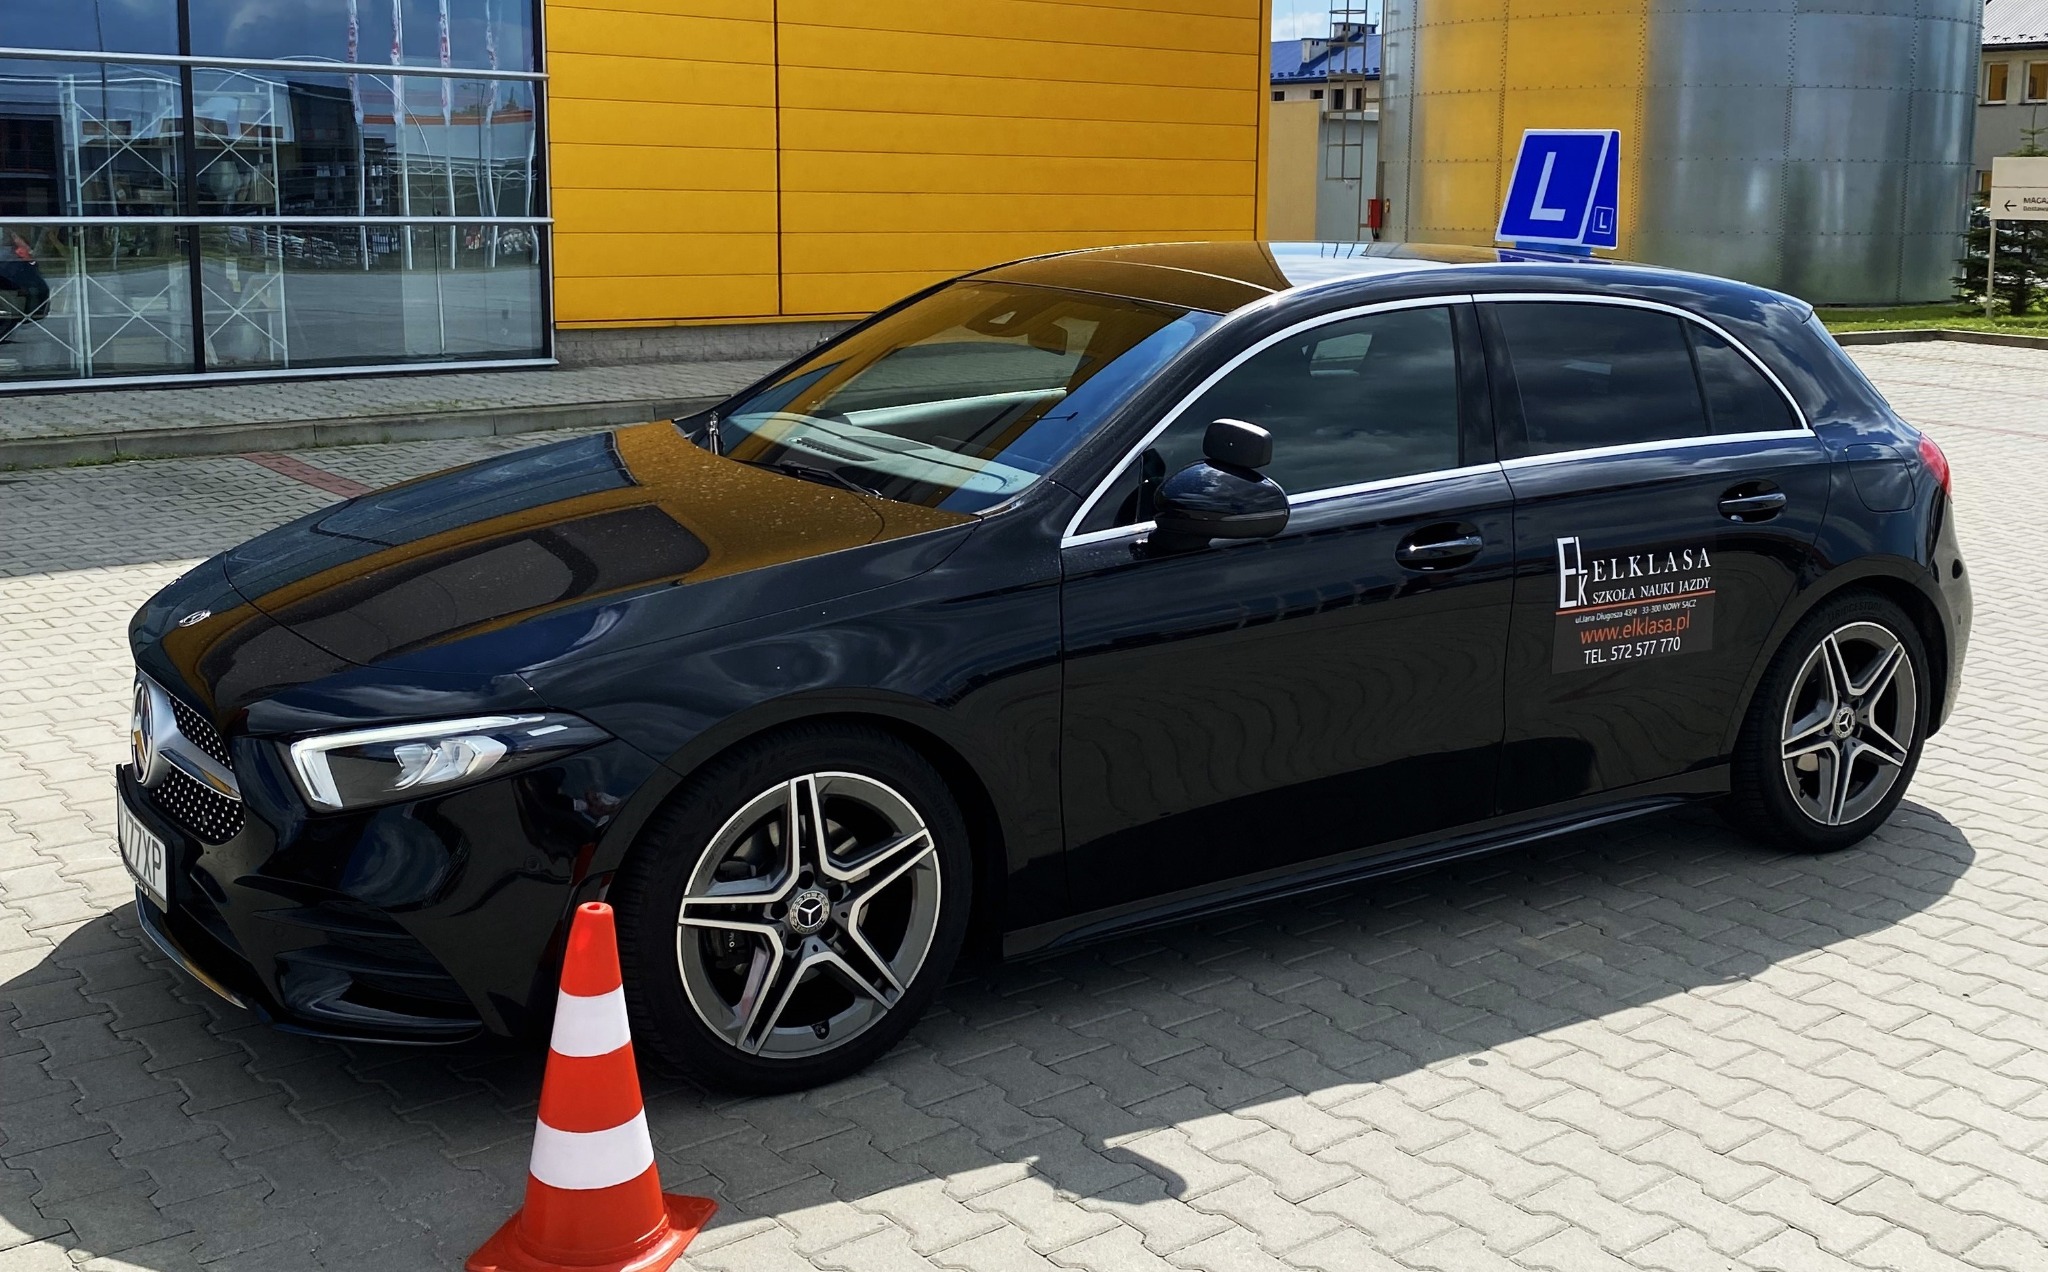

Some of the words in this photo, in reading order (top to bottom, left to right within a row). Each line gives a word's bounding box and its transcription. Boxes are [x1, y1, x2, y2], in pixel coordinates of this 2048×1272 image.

[1529, 151, 1567, 222] L
[1599, 211, 1608, 229] L
[1592, 547, 1712, 583] ELKLASA
[1640, 582, 1674, 598] NAUKI
[1678, 576, 1712, 594] JAZDY
[1641, 604, 1662, 615] 33-300
[1662, 602, 1681, 611] NOWY
[1580, 611, 1690, 645] www.elklasa.pl
[1610, 643, 1633, 661] 572
[1635, 640, 1657, 657] 577
[1660, 636, 1681, 653] 770
